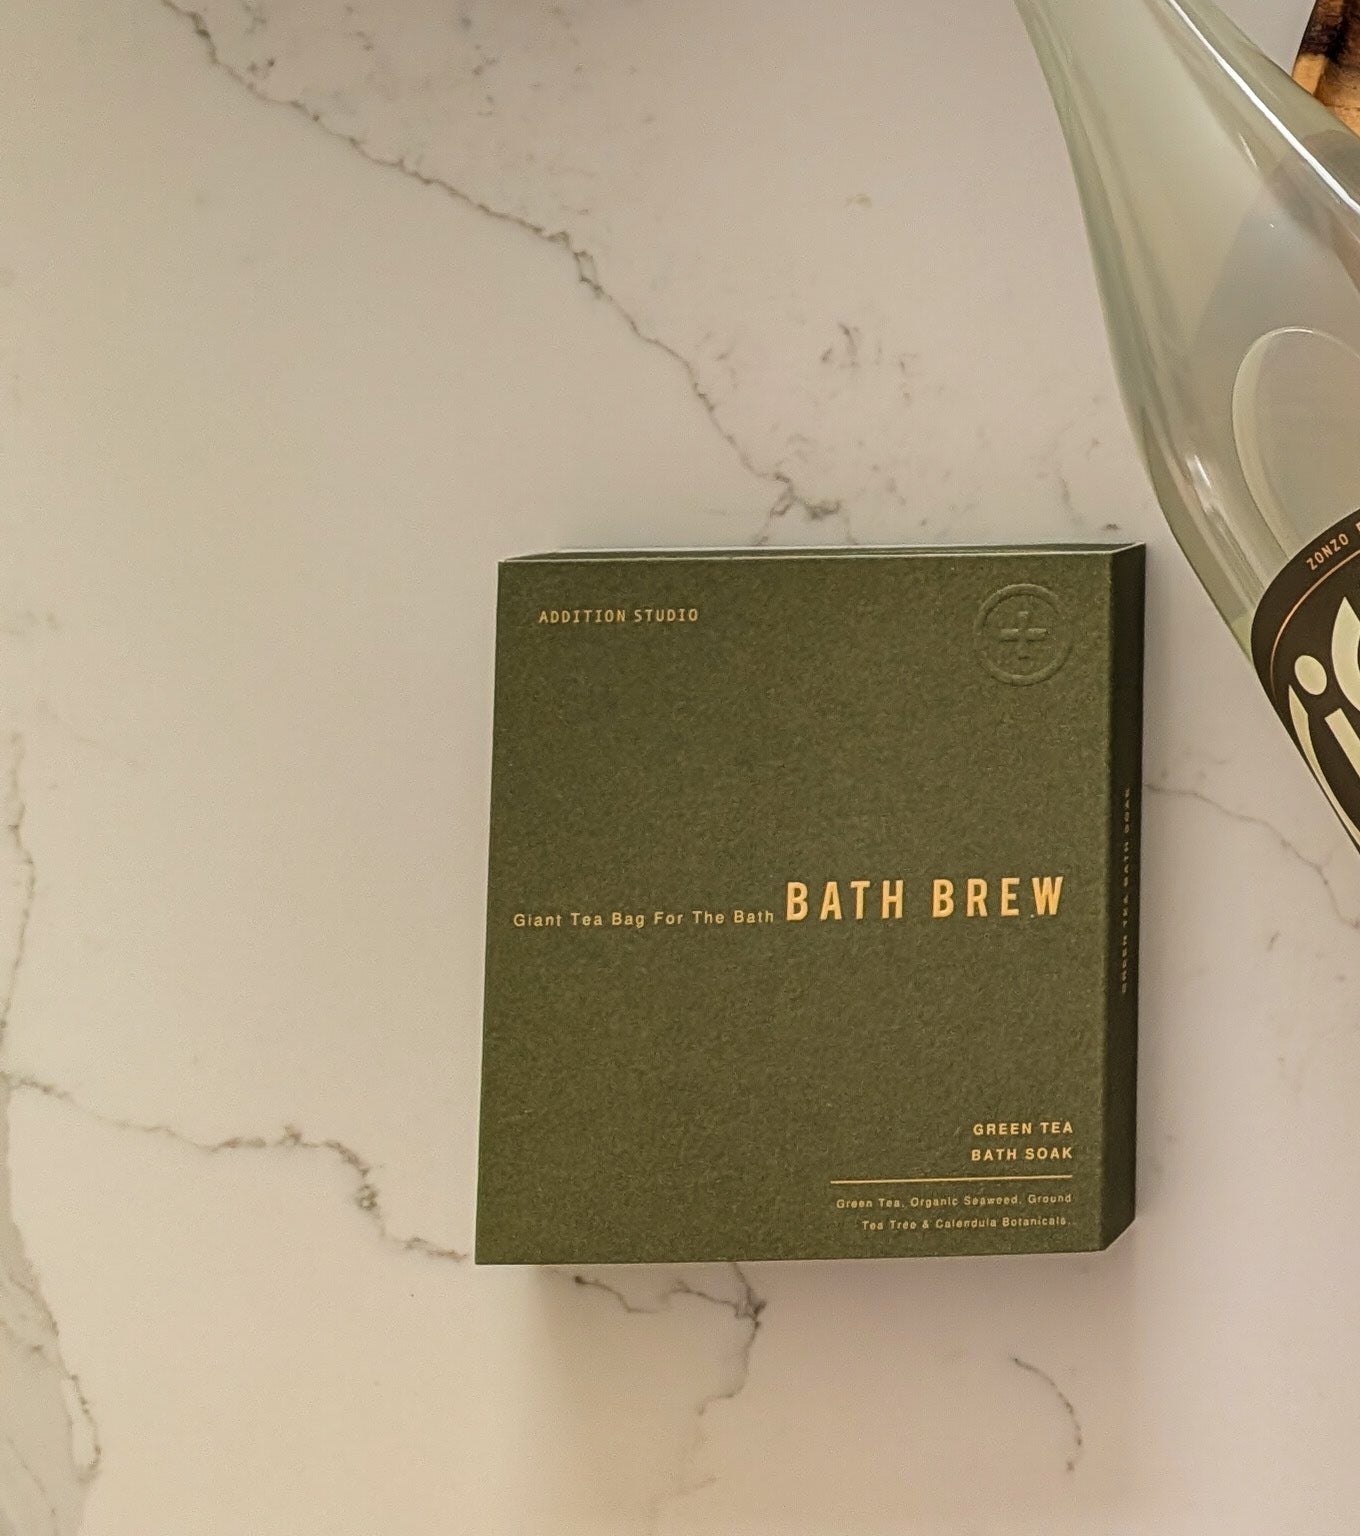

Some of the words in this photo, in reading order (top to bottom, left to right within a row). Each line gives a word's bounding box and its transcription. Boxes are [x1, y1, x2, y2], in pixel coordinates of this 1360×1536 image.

[1305, 531, 1351, 572] ZONZO
[538, 609, 626, 624] ADDITION
[633, 608, 699, 623] STUDIO
[786, 878, 904, 923] BATH
[931, 875, 1065, 919] BREW
[513, 912, 562, 928] Giant
[570, 912, 603, 927] Tea
[611, 912, 645, 929] Bag
[654, 911, 684, 926] For
[692, 910, 725, 925] The
[733, 909, 774, 924] Bath
[973, 1121, 1033, 1136] GREEN
[1040, 1120, 1073, 1135] TEA
[971, 1148, 1018, 1162] BATH
[1024, 1146, 1074, 1160] SOAK
[836, 1198, 873, 1209] Green
[910, 1196, 958, 1209] Organic
[1027, 1193, 1072, 1204] Ground
[862, 1220, 884, 1231] Tea
[889, 1219, 917, 1230] Tree
[922, 1219, 930, 1229] &
[935, 1217, 997, 1230] Calendula
